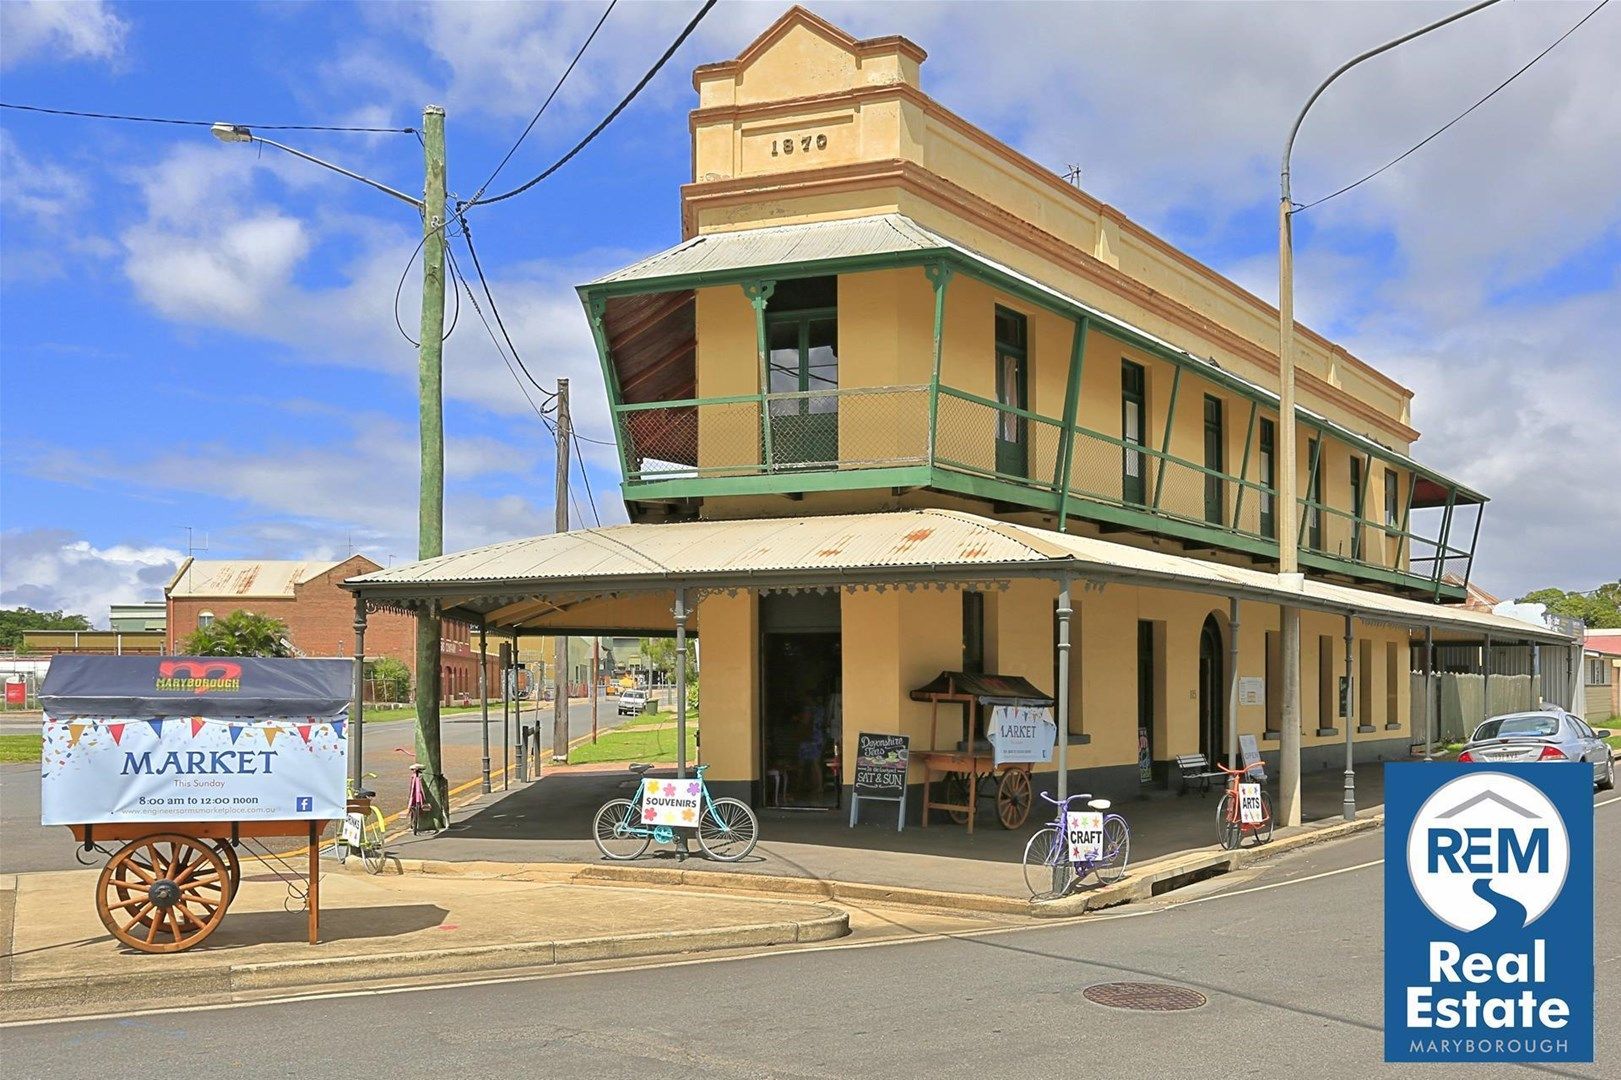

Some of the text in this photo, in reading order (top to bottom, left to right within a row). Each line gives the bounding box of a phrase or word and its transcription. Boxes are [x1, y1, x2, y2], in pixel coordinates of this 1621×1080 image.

[771, 133, 828, 157] 1870
[156, 678, 240, 689] MARYBOROUGH
[1245, 752, 1259, 760] OPEN
[120, 750, 278, 775] MARKET
[194, 780, 226, 788] Sunday
[858, 772, 902, 785] SAT & SUN
[139, 796, 165, 805] 8:00
[201, 797, 230, 805] 12:00
[646, 797, 697, 807] SOUVENIRS
[1243, 797, 1260, 809] ARTS
[1070, 830, 1102, 844] CRAFT
